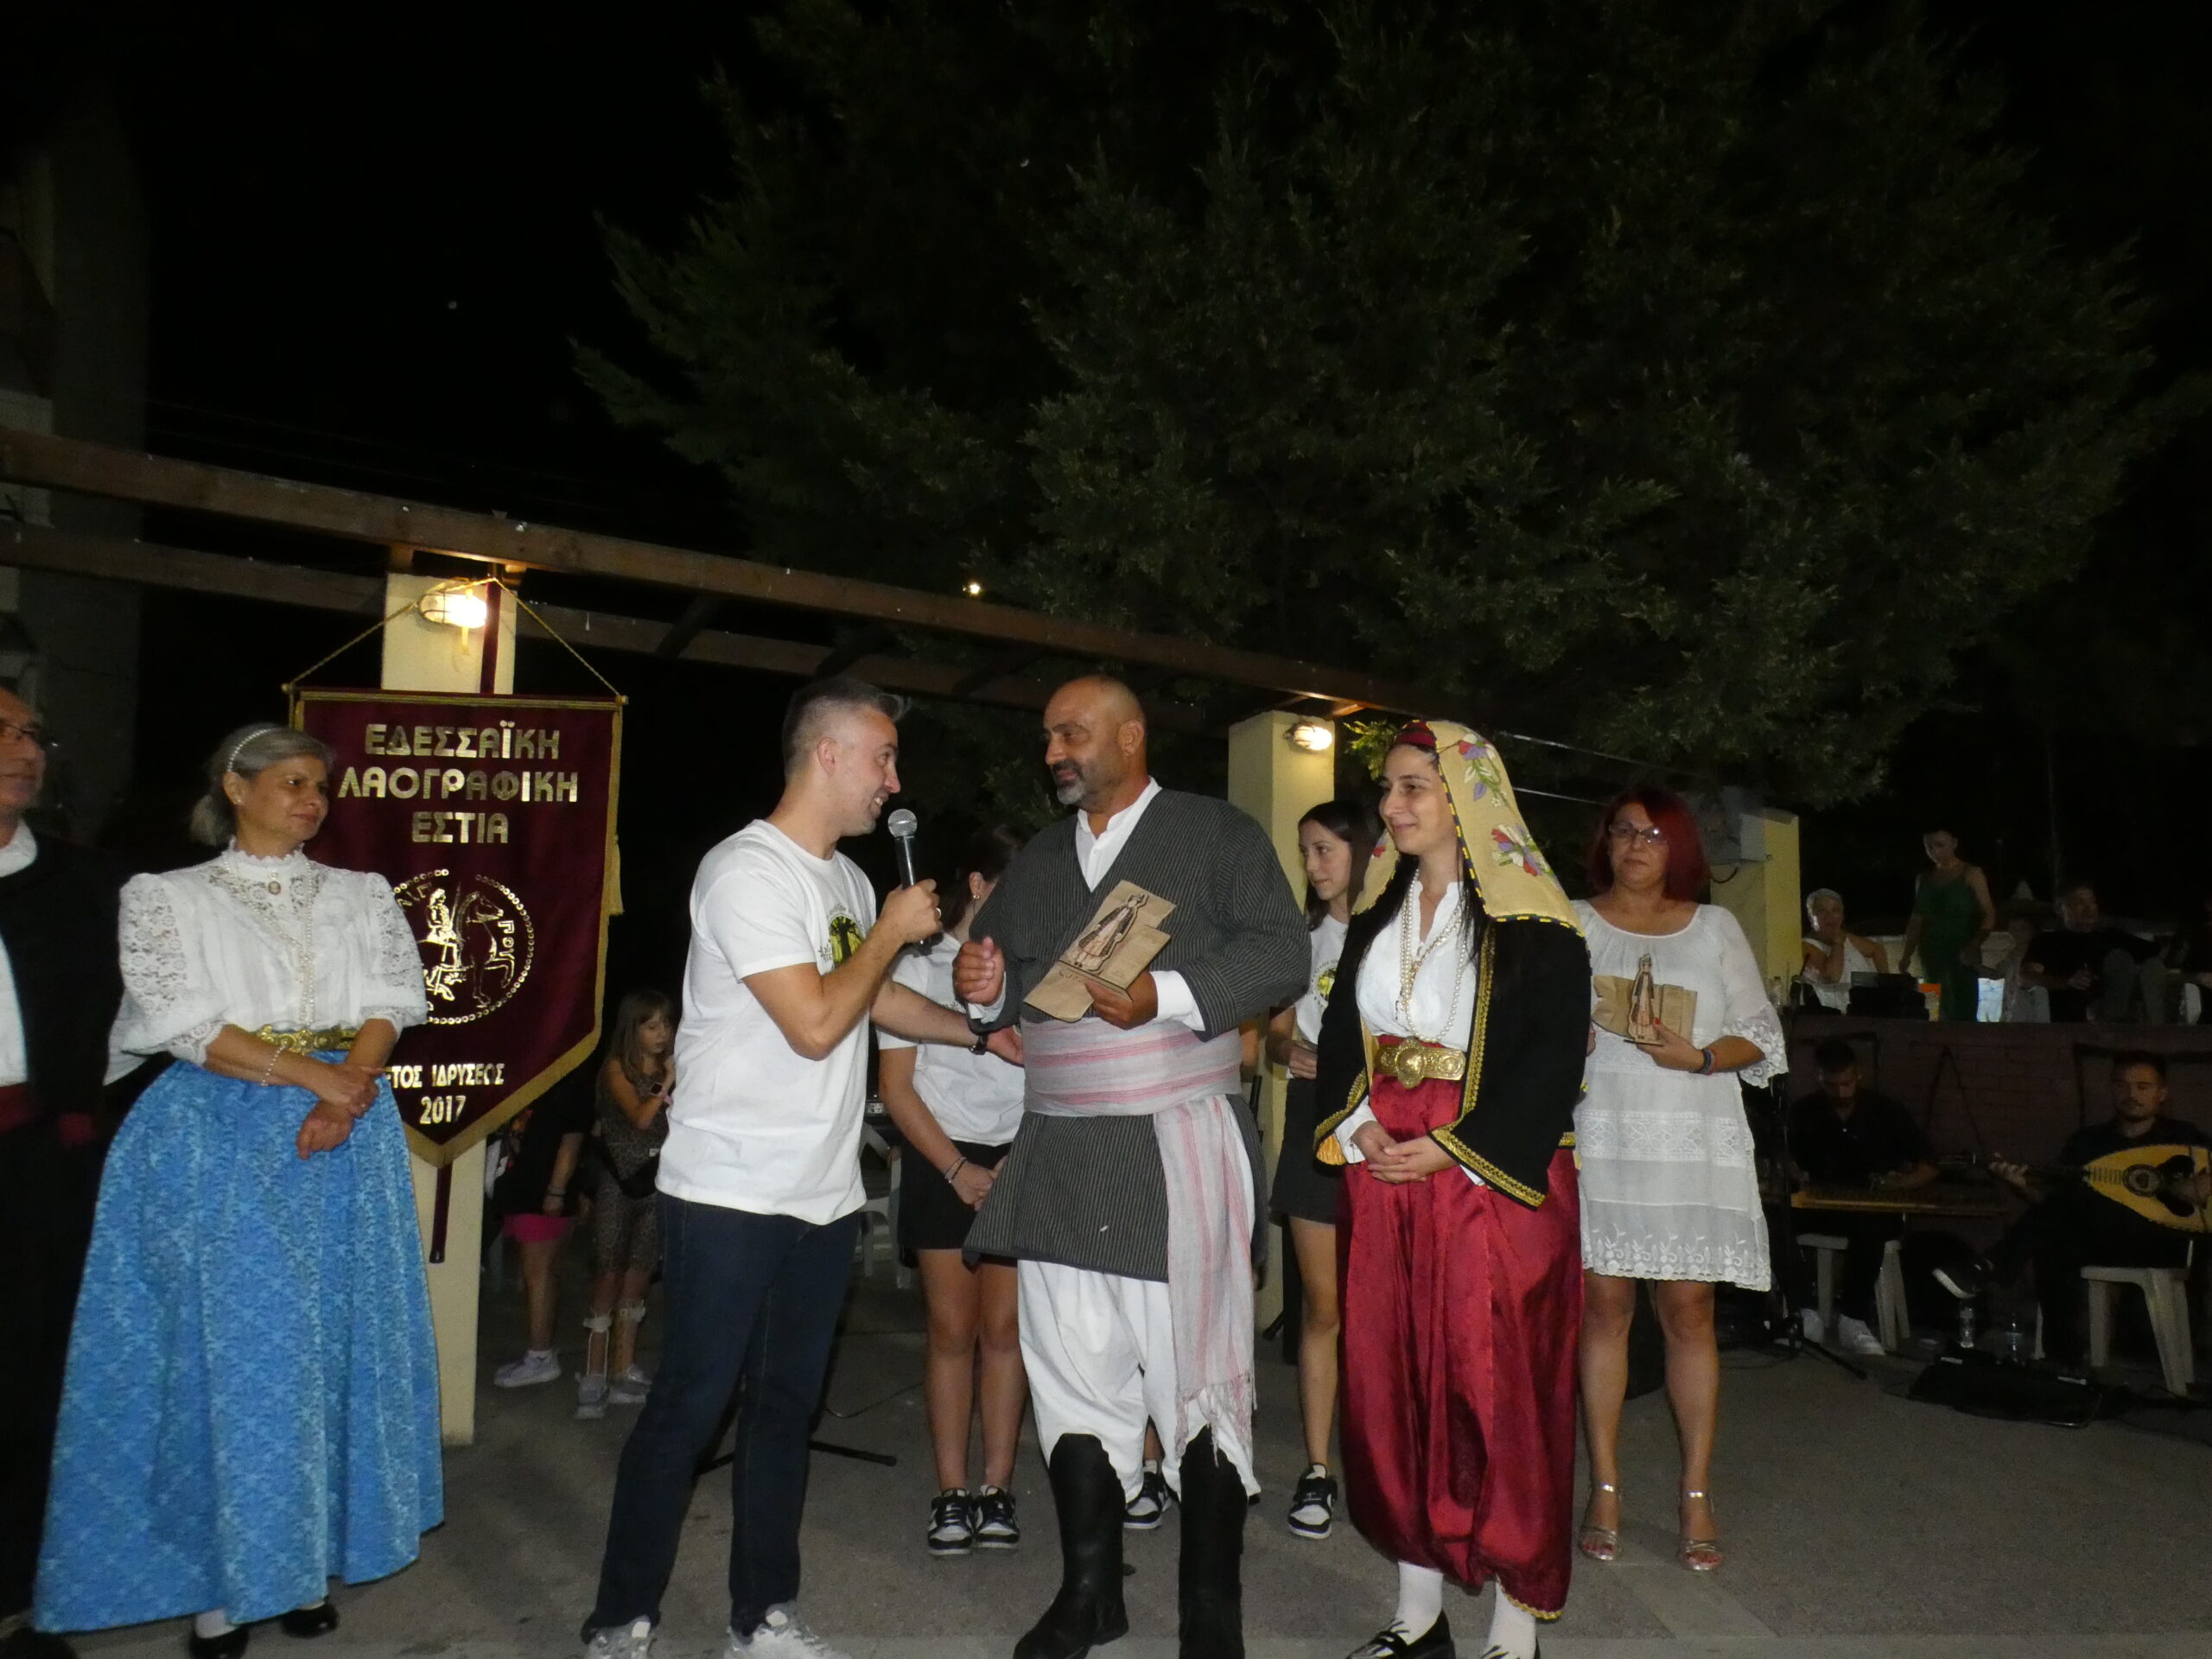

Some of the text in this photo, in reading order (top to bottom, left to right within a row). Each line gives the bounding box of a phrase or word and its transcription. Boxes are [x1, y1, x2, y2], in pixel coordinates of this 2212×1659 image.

[365, 720, 561, 760] ΕΔΕΣΣΑΪΚΗ
[338, 766, 579, 802] ΛΑΟΓΡΑΦΙΚΗ
[412, 811, 509, 843] ΕΣΤΙΑ
[419, 1095, 467, 1125] 2017
